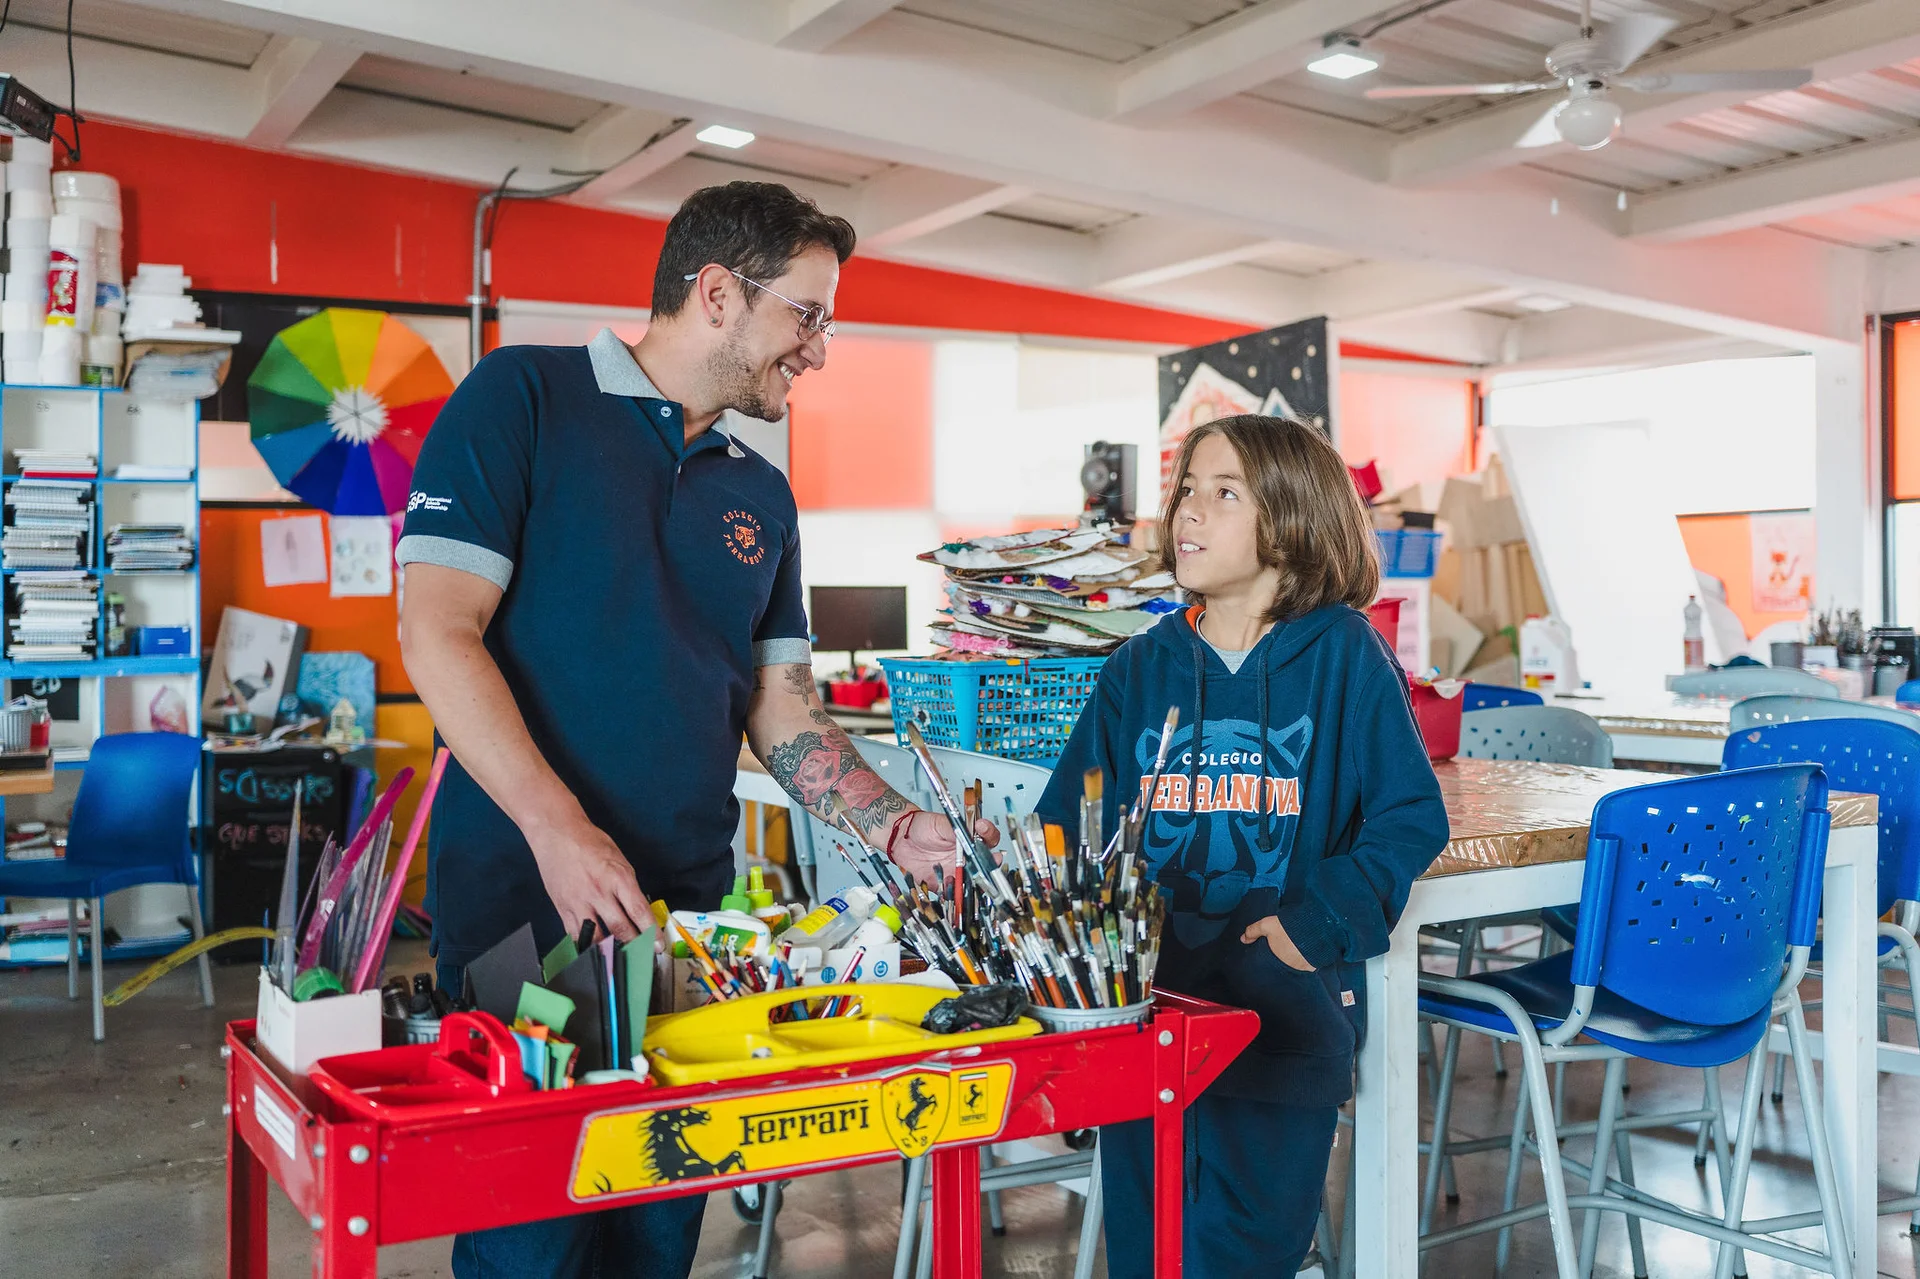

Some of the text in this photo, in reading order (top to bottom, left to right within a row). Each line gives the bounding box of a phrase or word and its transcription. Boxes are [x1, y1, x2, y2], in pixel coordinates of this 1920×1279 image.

[723, 510, 761, 531] COLEGIO
[723, 534, 765, 565] TERRANOVA
[1181, 752, 1263, 766] COLEGIO
[1140, 773, 1302, 817] TERRANOVA
[738, 1099, 870, 1146] Ferrari
